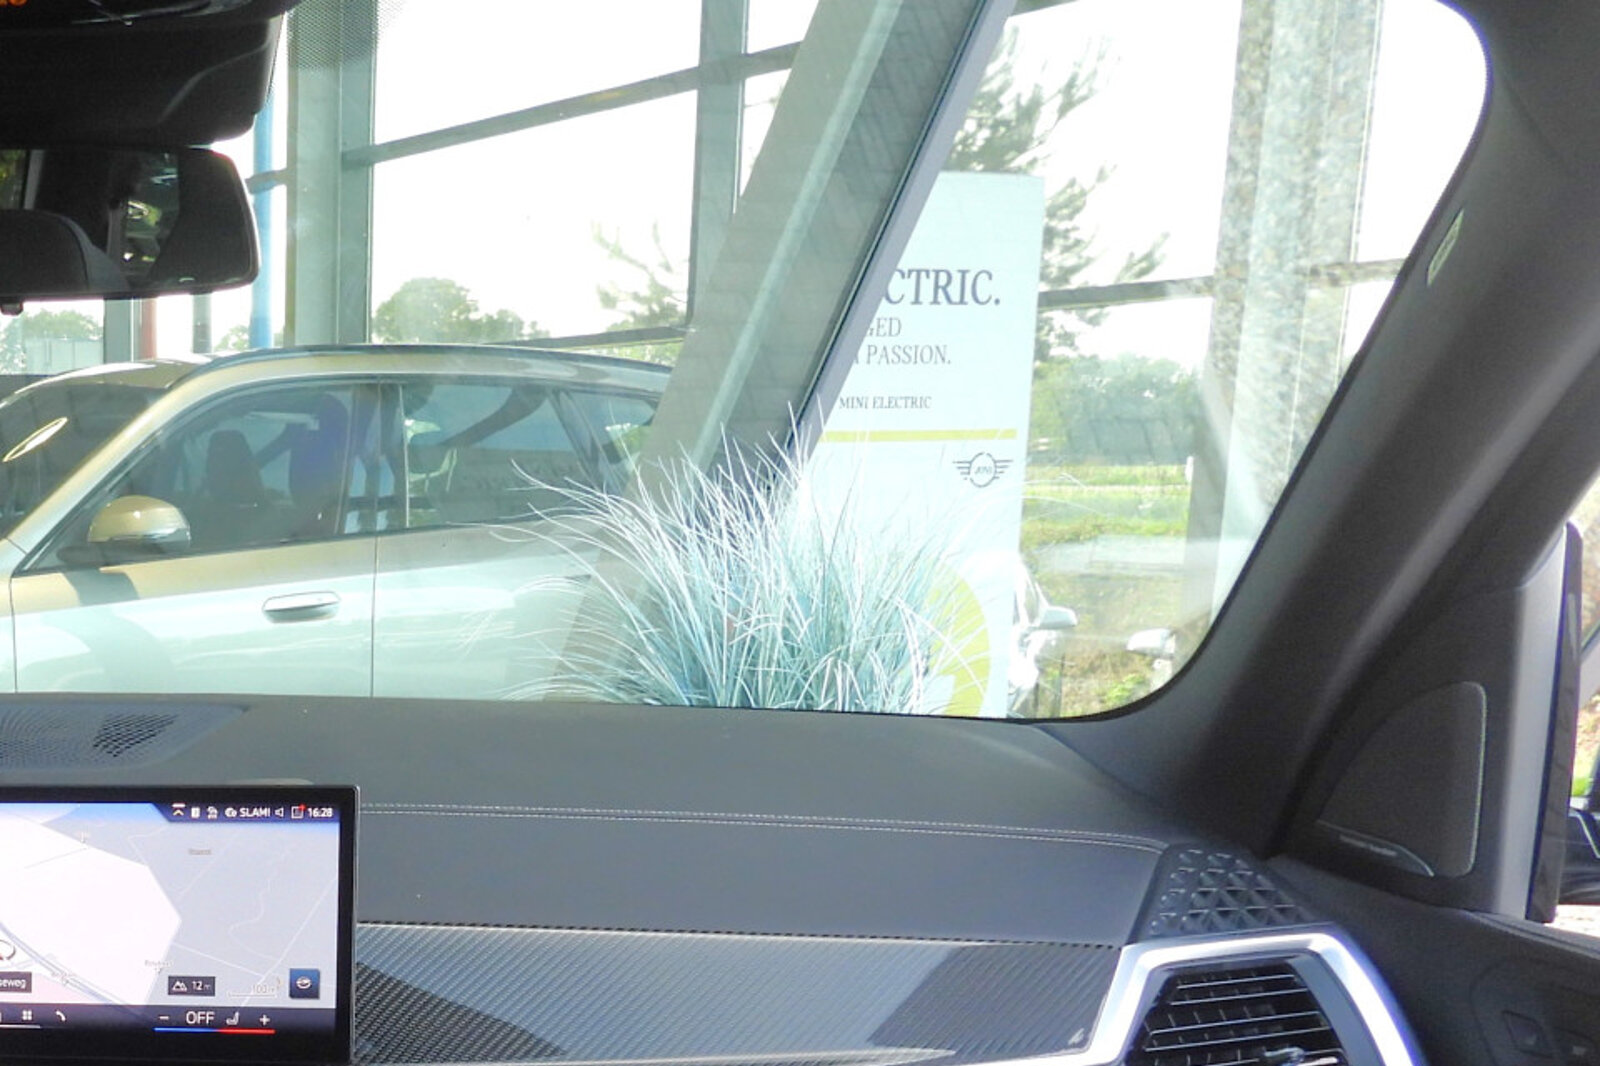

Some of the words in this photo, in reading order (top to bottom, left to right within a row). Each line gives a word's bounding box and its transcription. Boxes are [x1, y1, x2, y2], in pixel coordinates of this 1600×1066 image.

[866, 344, 952, 365] PASSION.
[872, 396, 932, 409] ELECTRIC
[307, 807, 334, 818] 16:28
[186, 1011, 215, 1025] OFF
